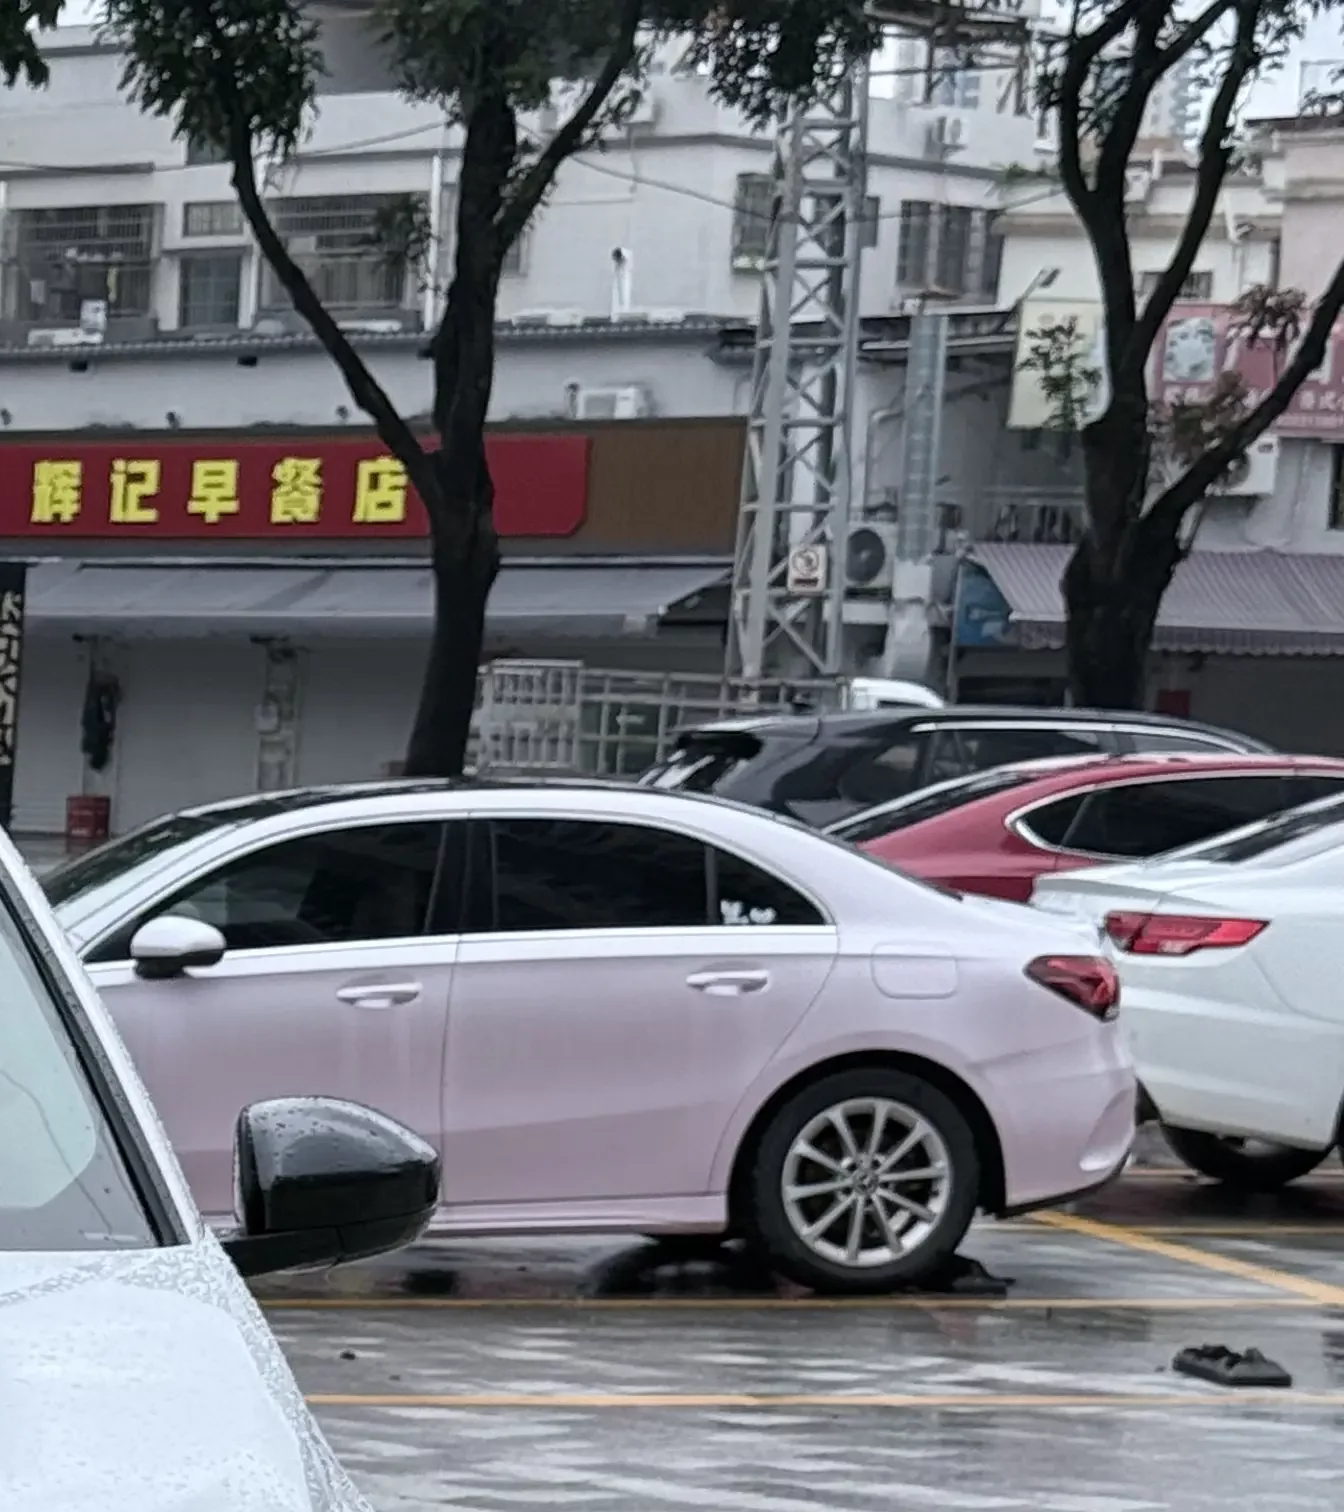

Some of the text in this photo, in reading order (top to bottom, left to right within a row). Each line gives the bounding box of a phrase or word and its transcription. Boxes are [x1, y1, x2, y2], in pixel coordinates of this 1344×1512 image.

[30, 456, 409, 524] 辉记早餐店
